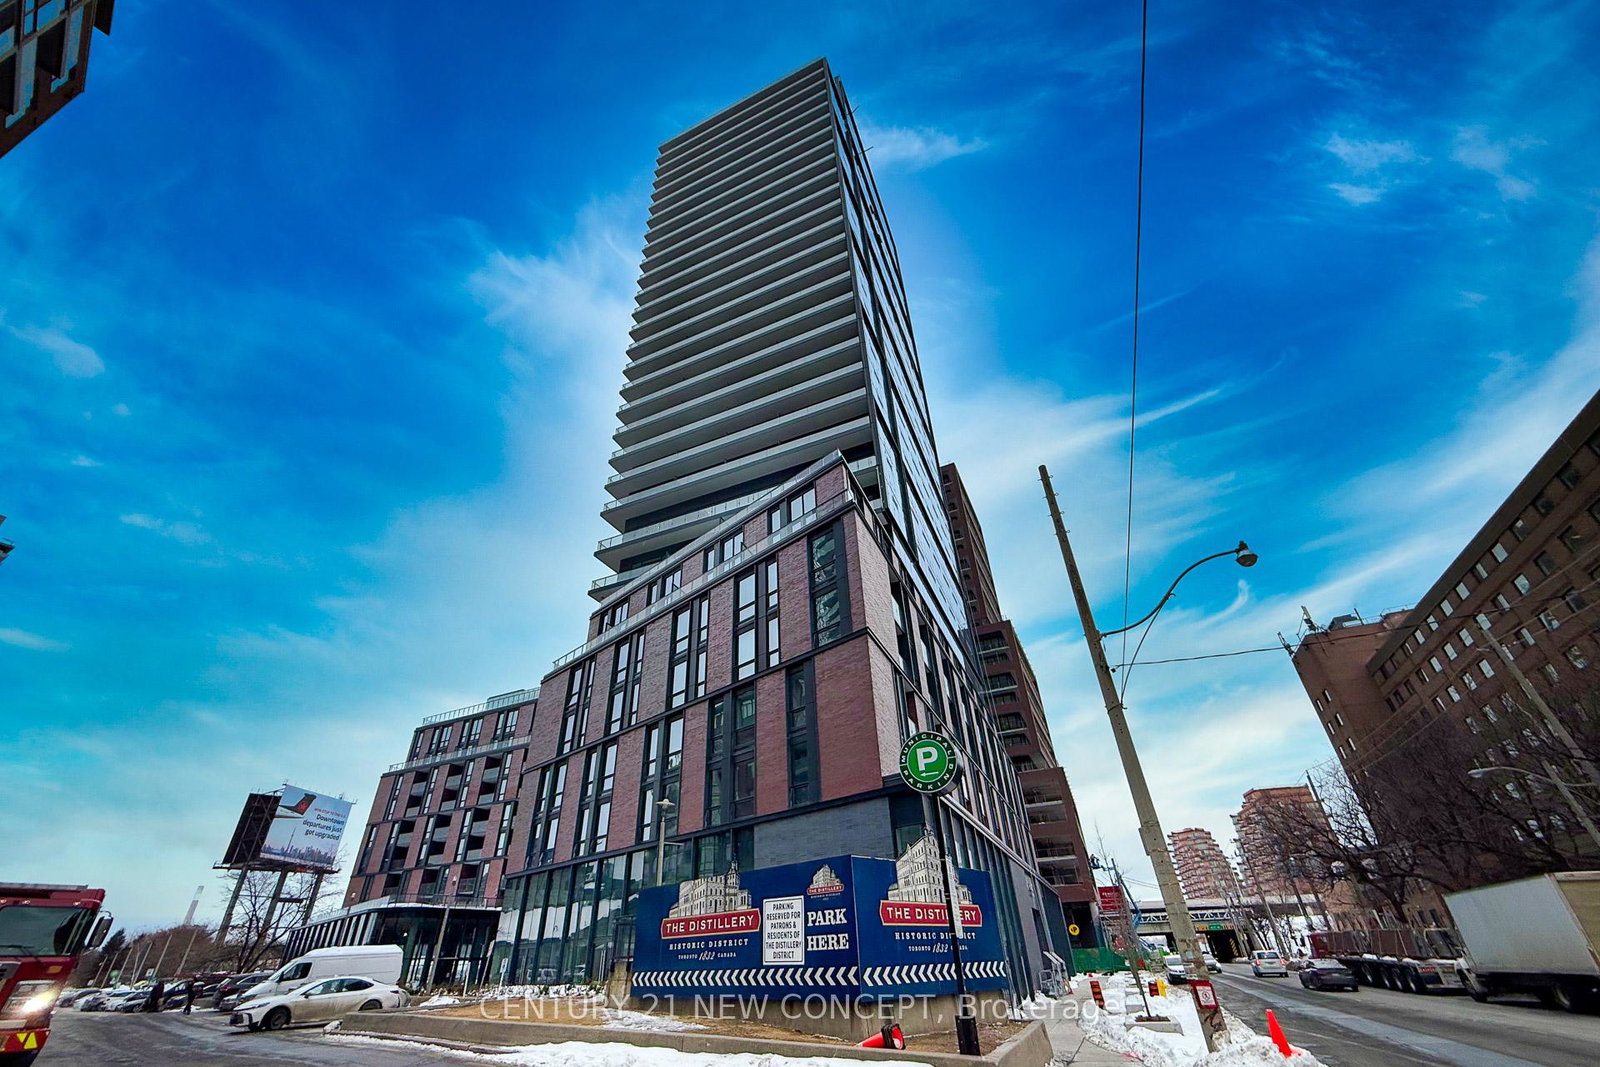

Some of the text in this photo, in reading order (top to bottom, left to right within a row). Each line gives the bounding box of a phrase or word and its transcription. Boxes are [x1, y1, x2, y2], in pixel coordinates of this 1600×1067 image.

[901, 734, 952, 762] MUNICIPAL
[916, 746, 938, 771] P
[903, 764, 954, 790] PARKING
[316, 814, 344, 825] Downtown
[303, 819, 342, 833] departures just
[315, 830, 340, 840] upgraded
[772, 902, 795, 911] PARKING
[766, 911, 801, 920] RESERVED FOR
[807, 908, 848, 926] PARK
[886, 907, 911, 919] THE
[666, 915, 754, 933] THE DISTILLERY
[770, 922, 793, 930] PATRONS
[767, 930, 800, 940] RESIDENTS OF
[895, 932, 937, 940] HISTORIC
[669, 939, 749, 951] HISTORIC DISTRICT
[766, 940, 802, 950] THE DISTILLERY
[807, 933, 849, 951] HERE
[932, 942, 948, 953] 1832
[698, 950, 716, 961] 1832
[773, 951, 795, 959] DISTRICT
